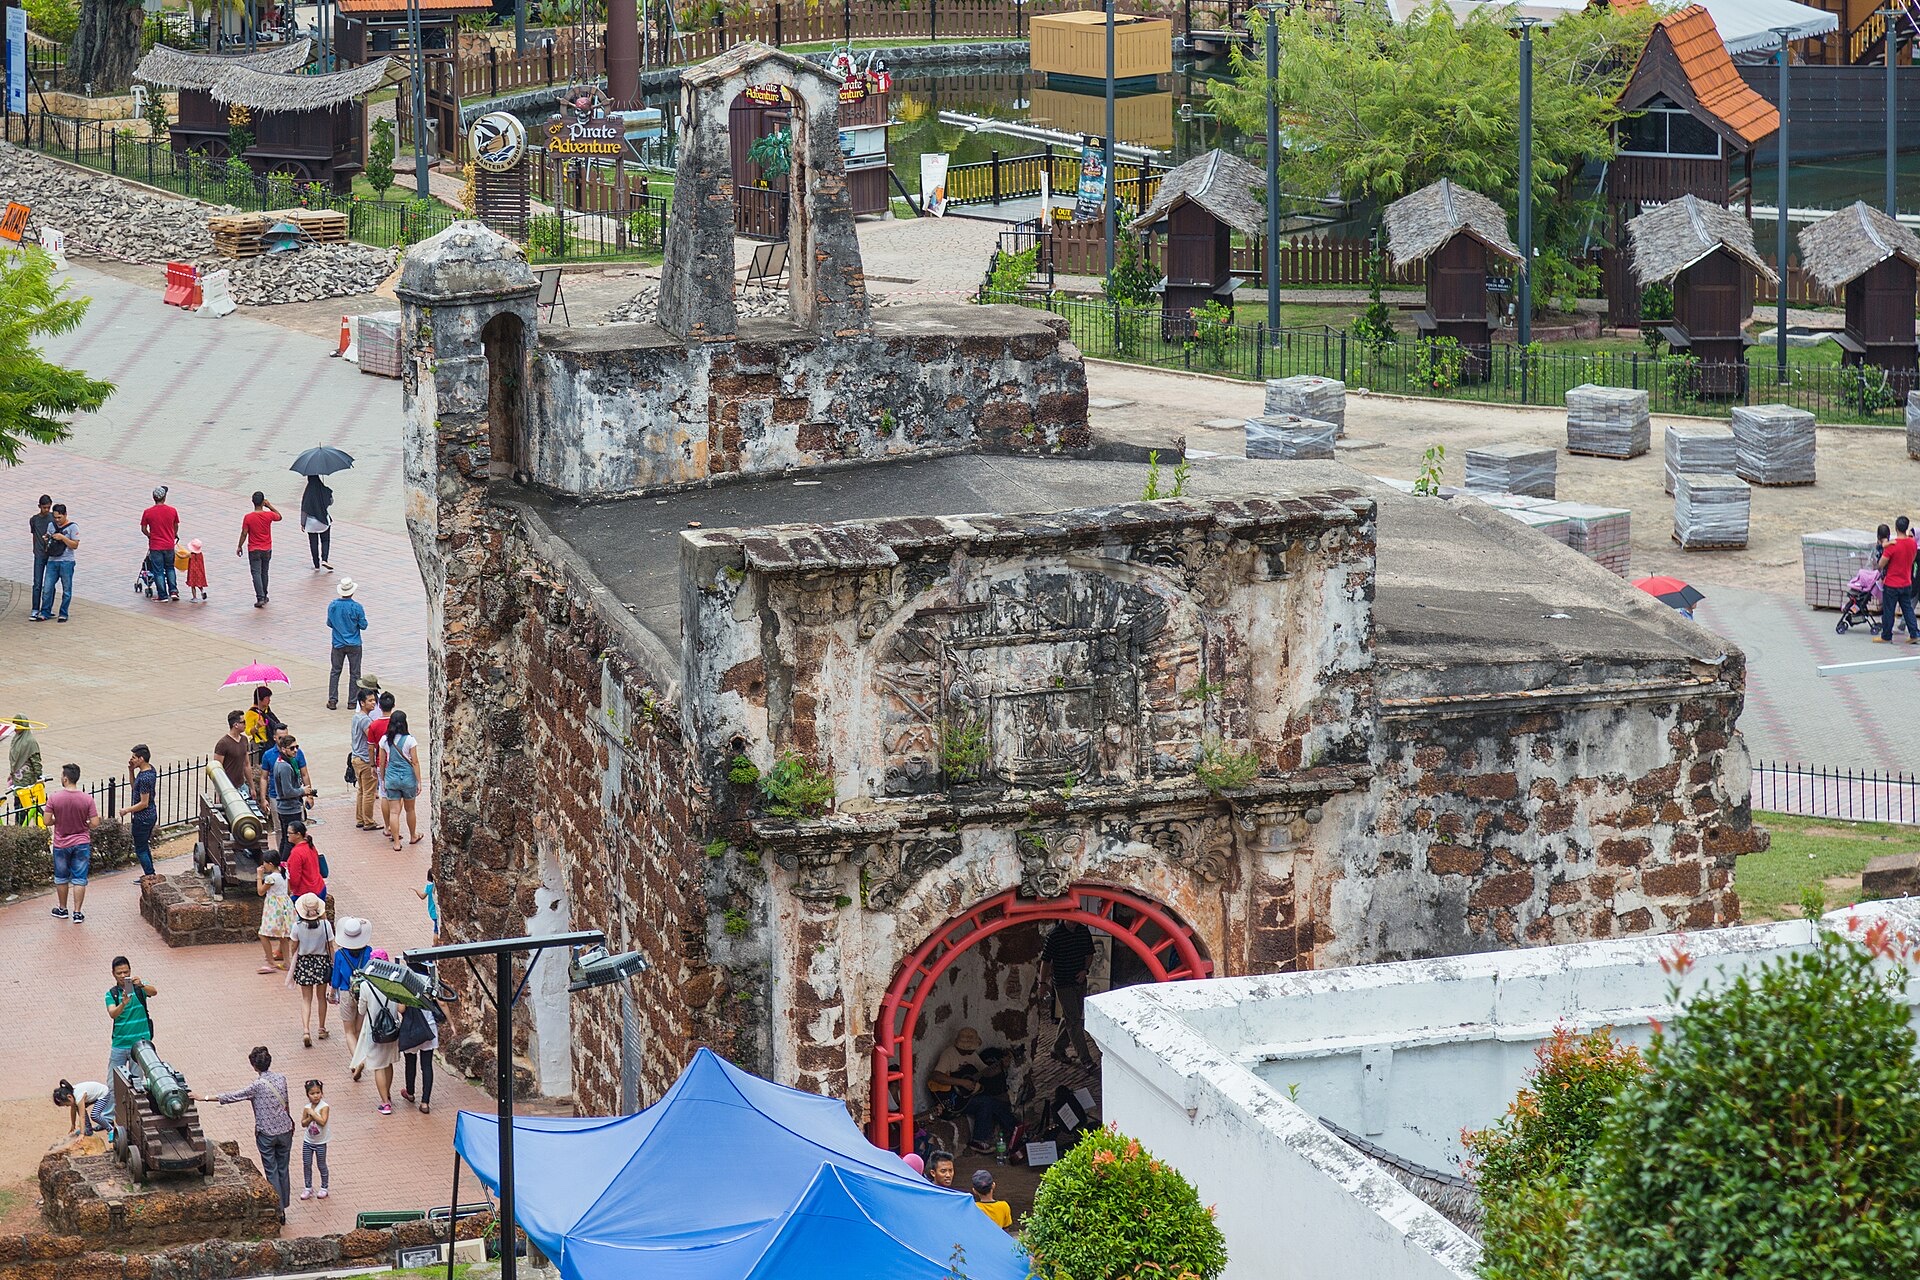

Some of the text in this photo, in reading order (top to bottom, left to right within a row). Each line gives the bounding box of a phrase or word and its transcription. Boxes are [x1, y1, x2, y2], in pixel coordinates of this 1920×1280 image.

[745, 87, 780, 102] Adventure
[548, 122, 618, 141] The Pirate
[475, 134, 522, 170] BAHTERA MERDEKA
[548, 136, 622, 155] Adventure
[2, 207, 27, 234] AWAS
